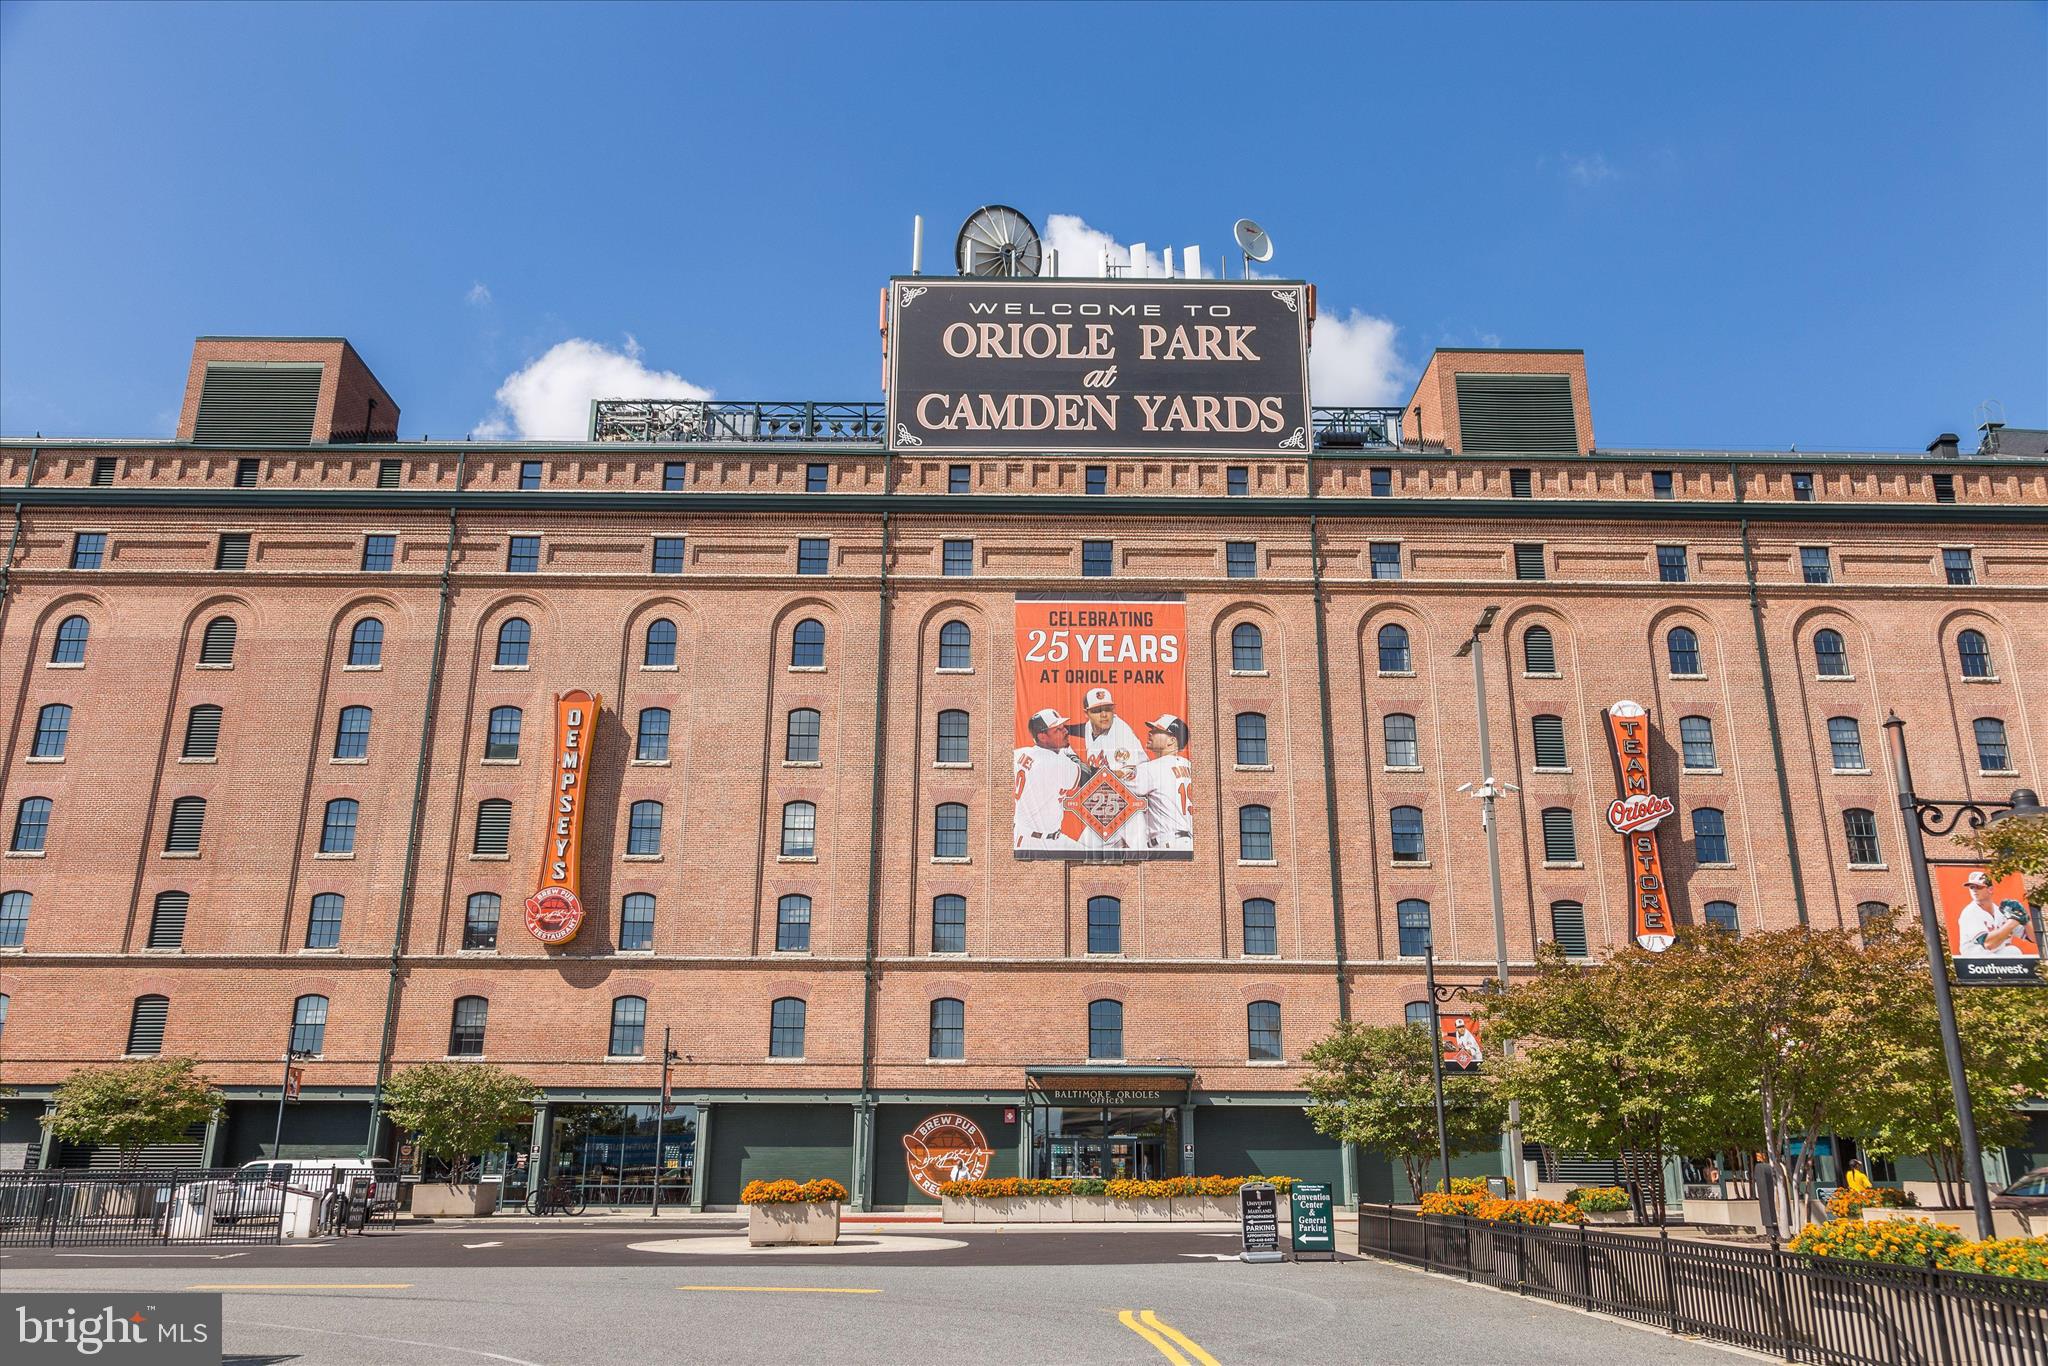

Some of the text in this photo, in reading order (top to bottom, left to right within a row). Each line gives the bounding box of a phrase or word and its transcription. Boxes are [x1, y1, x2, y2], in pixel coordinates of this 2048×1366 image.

[968, 302, 1231, 317] WELCOME TO
[942, 322, 1260, 361] ORIOLE PARK
[1083, 364, 1118, 388] at
[916, 393, 1285, 433] CAMDEN YARDS
[1049, 611, 1153, 627] CELEBRATING
[1025, 630, 1179, 663] 25 YEARS
[1040, 669, 1164, 684] AT ORIOLE PARK
[1620, 721, 1645, 790] TEAM
[551, 707, 582, 881] DEMPSEYS
[1611, 797, 1672, 830] Orioles
[1637, 837, 1663, 928] STORE
[537, 889, 576, 901] BREW PUB
[534, 917, 577, 939] RESTAURANT
[1968, 963, 2023, 974] Southwest
[1055, 1090, 1110, 1098] BALTIMORE
[919, 1116, 977, 1136] BREW PUB
[1299, 1224, 1327, 1233] Parking
